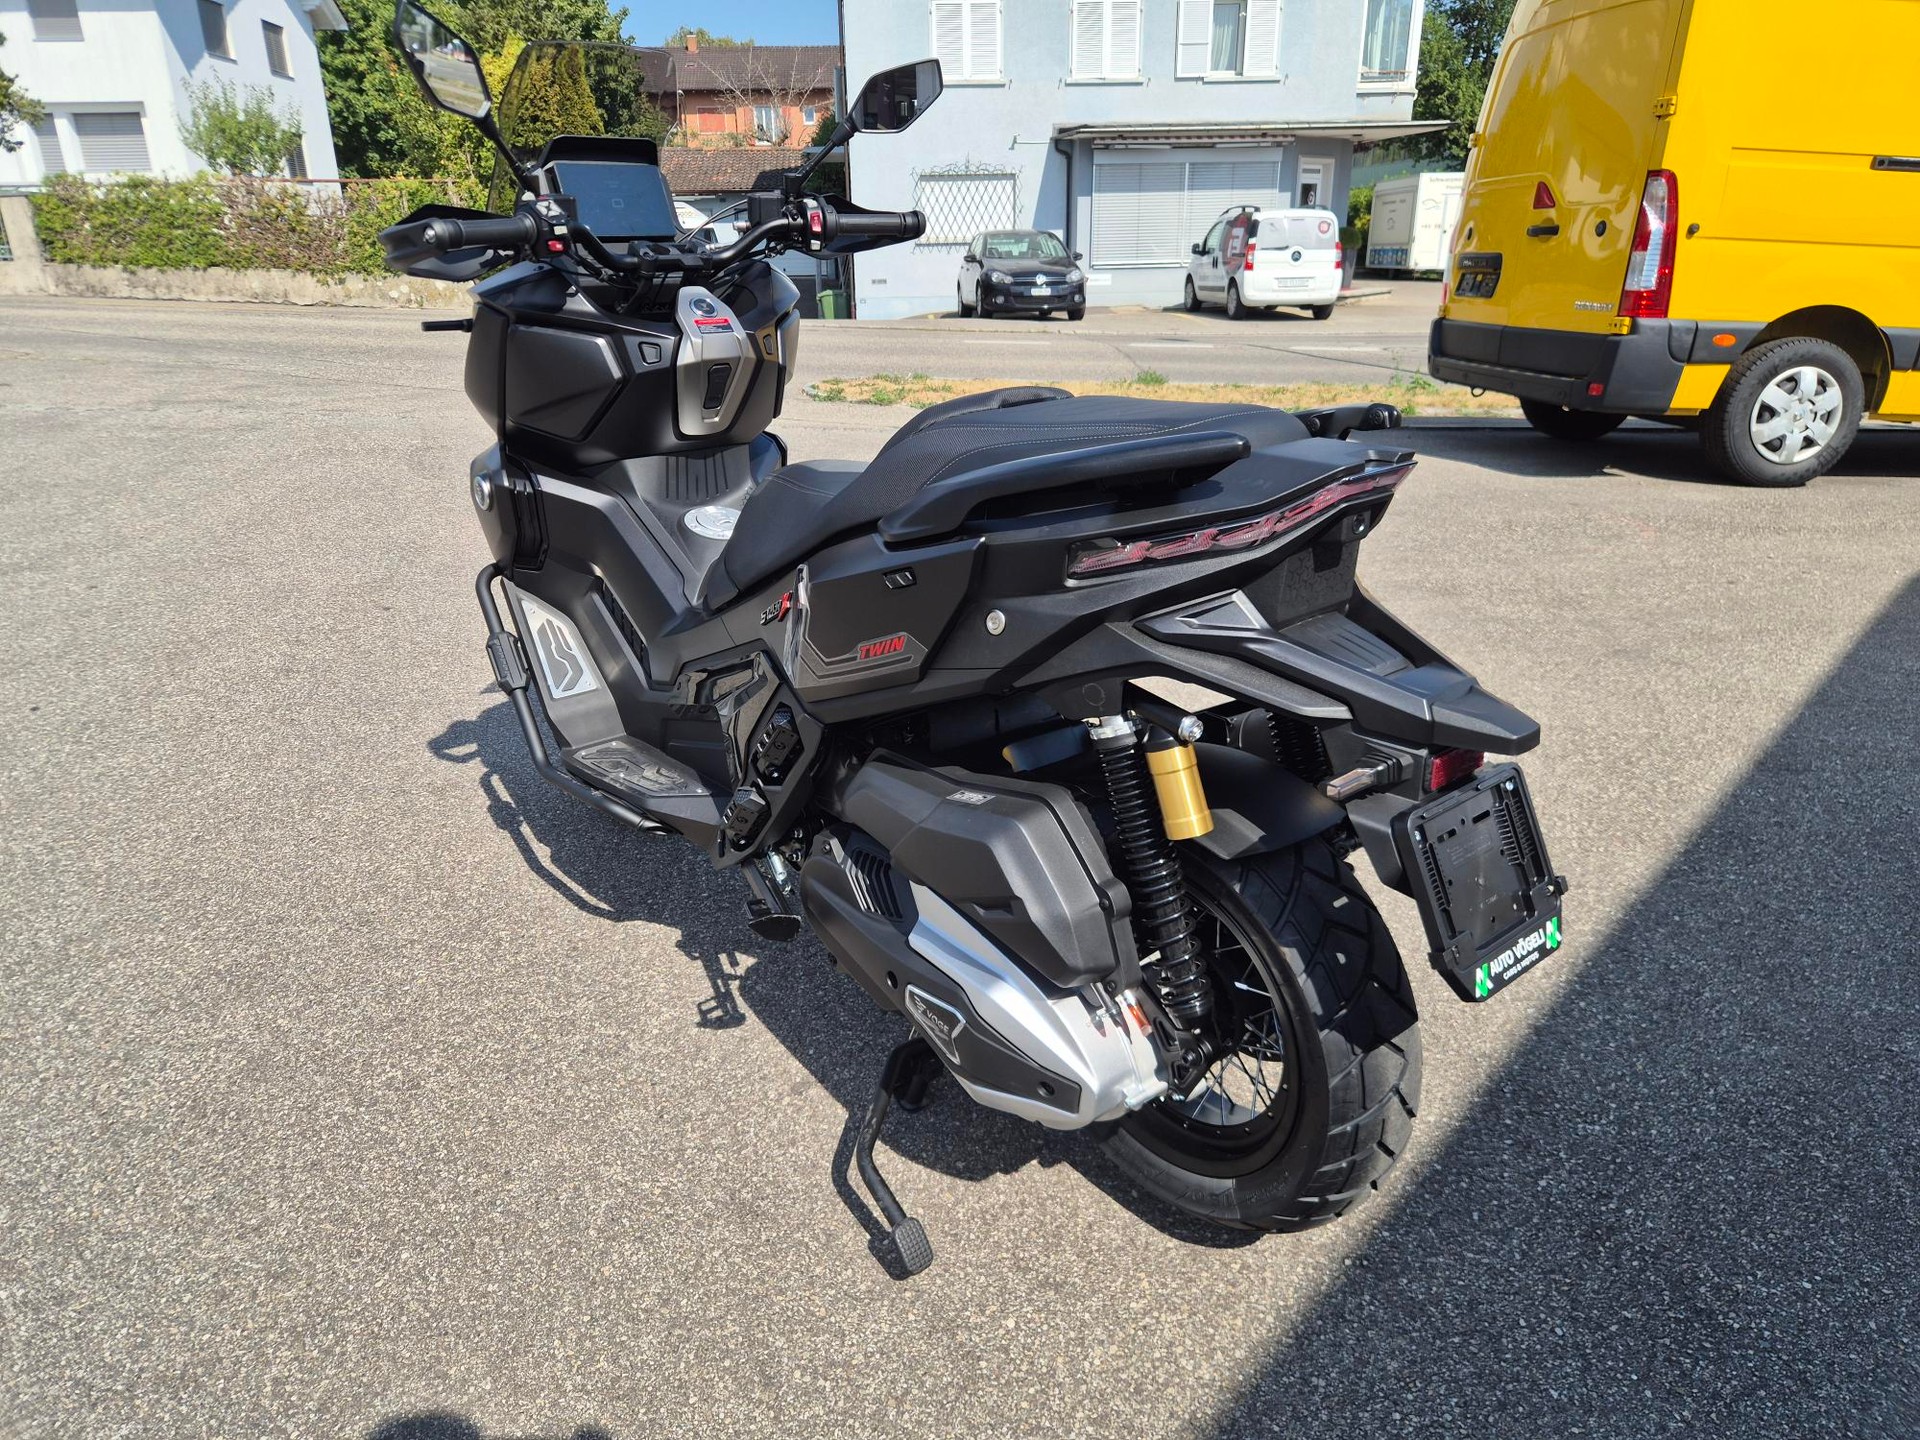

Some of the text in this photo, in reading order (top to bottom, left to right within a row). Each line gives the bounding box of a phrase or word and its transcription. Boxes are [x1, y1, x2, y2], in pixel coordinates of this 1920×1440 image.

[859, 635, 906, 660] TWIN
[1490, 928, 1545, 977] AUTO VÖGELI
[926, 1009, 949, 1032] VOGE
